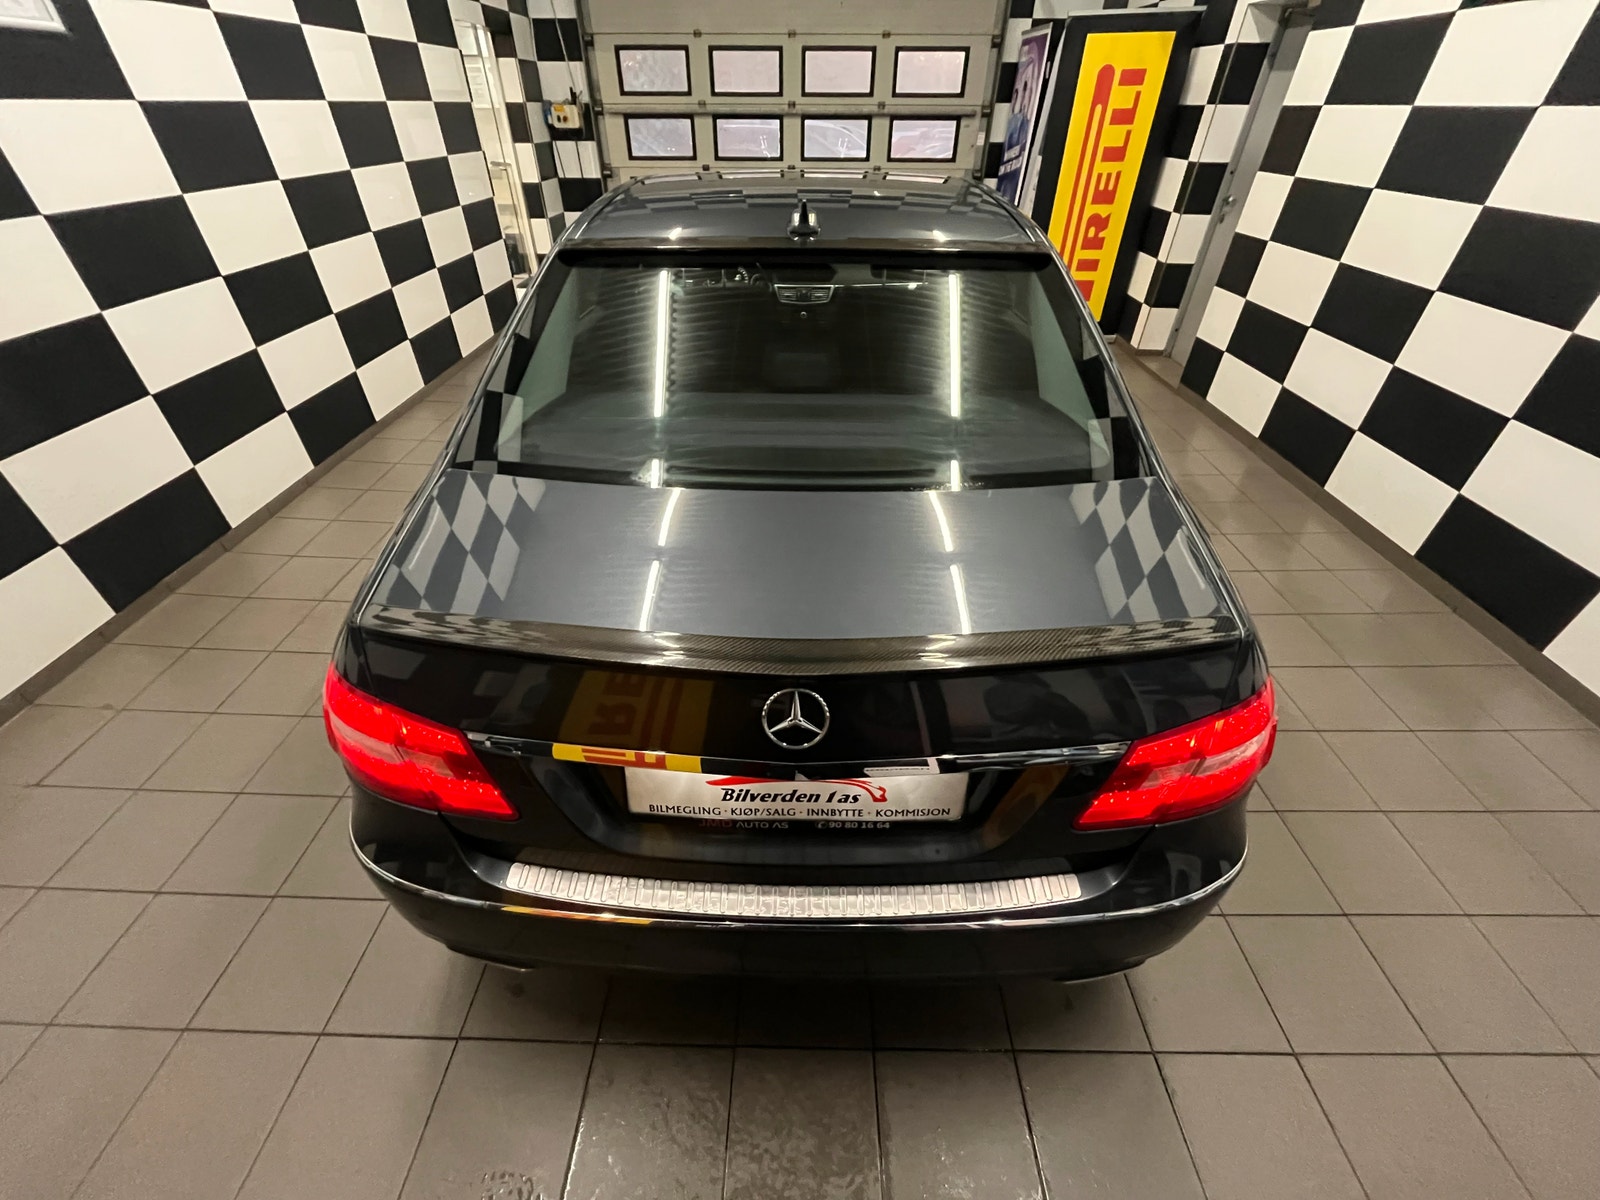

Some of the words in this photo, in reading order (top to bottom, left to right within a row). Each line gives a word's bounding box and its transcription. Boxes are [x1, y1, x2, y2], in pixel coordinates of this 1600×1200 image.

[720, 787, 822, 804] Bilverden
[837, 793, 862, 804] as
[648, 804, 722, 816] BILMEGLING
[730, 807, 797, 817] KJØP/SALG
[806, 808, 864, 818] INNBYTTE
[875, 807, 951, 818] KOMMISJON
[735, 821, 769, 829] AUTO
[771, 821, 789, 829] AS
[828, 821, 843, 829] 90
[844, 821, 859, 829] 80
[861, 821, 875, 829] 16
[876, 821, 890, 829] 64
